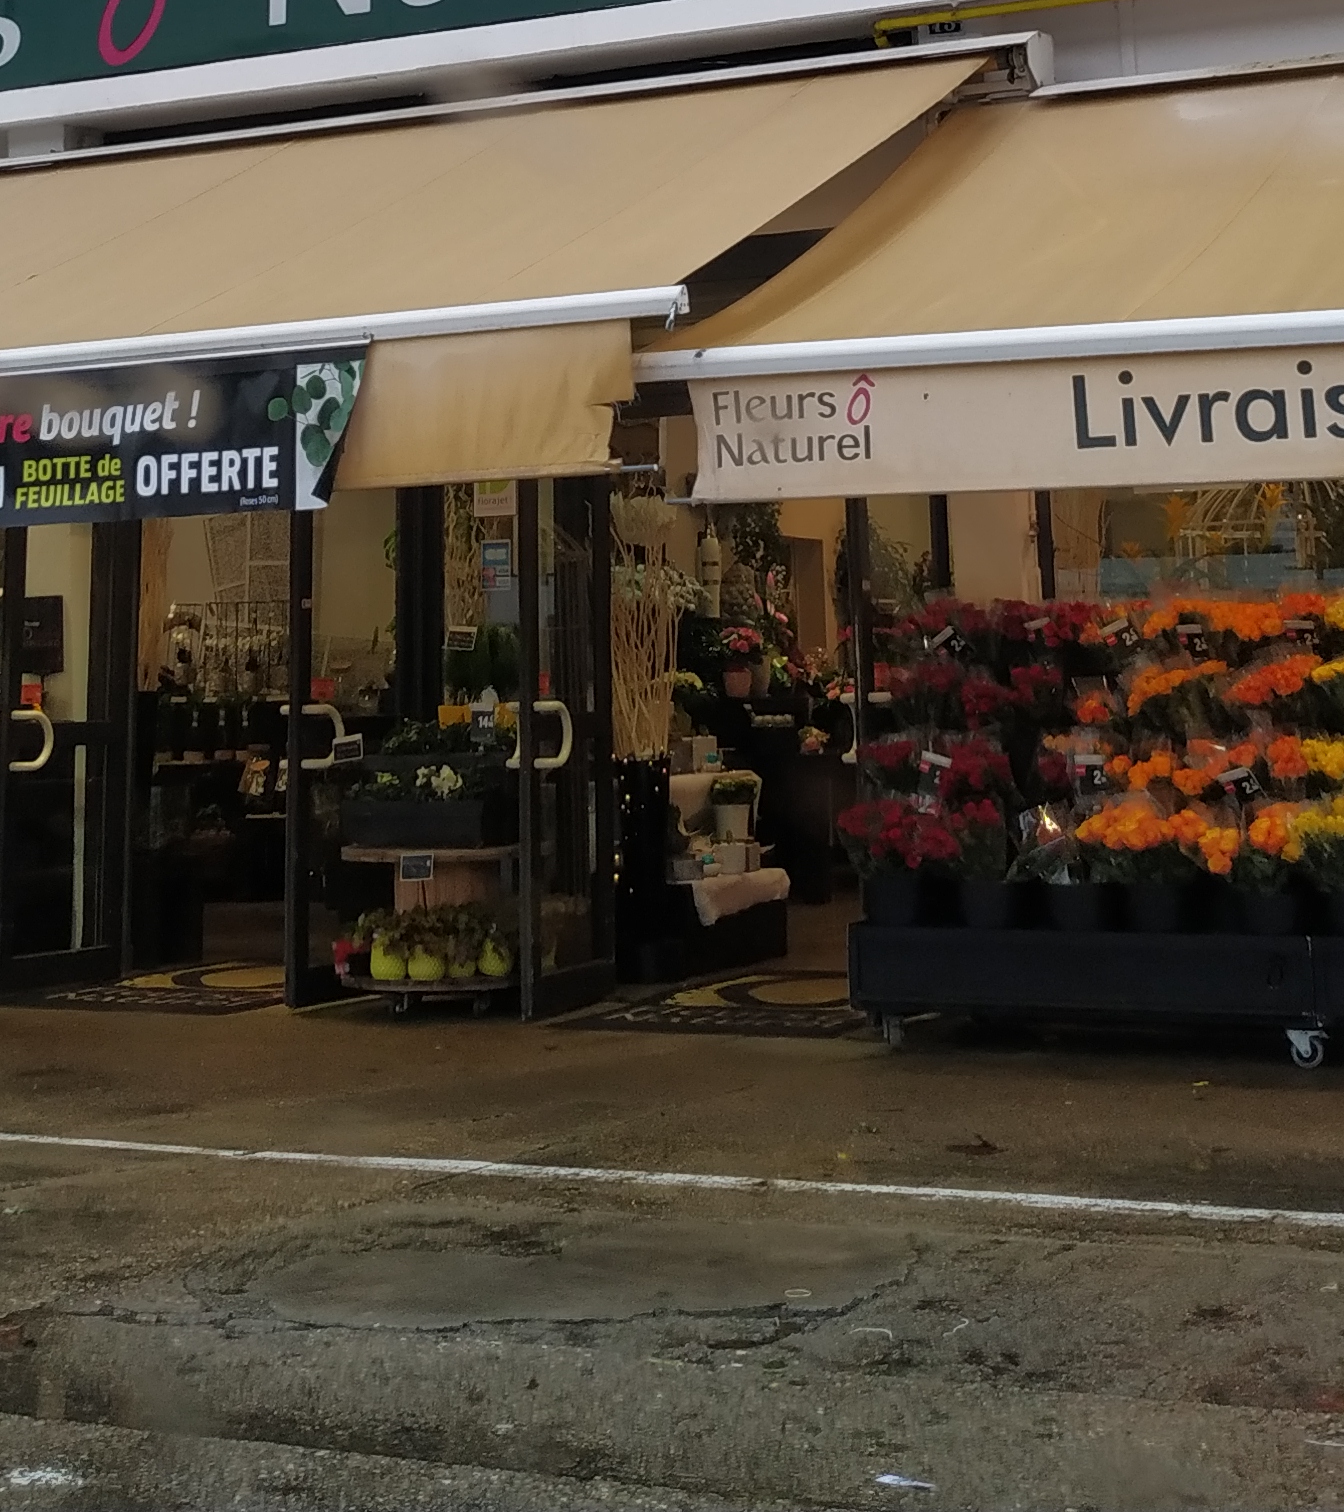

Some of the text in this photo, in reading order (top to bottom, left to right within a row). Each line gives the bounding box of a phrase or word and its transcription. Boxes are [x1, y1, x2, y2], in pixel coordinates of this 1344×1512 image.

[39, 391, 180, 446] bouquet
[187, 390, 201, 428] !
[712, 373, 876, 427] Fleurs ô
[22, 453, 122, 483] BOTTE de
[136, 445, 279, 497] OFFERTE
[716, 425, 872, 479] Naturel
[14, 479, 126, 510] FEUILLAGE
